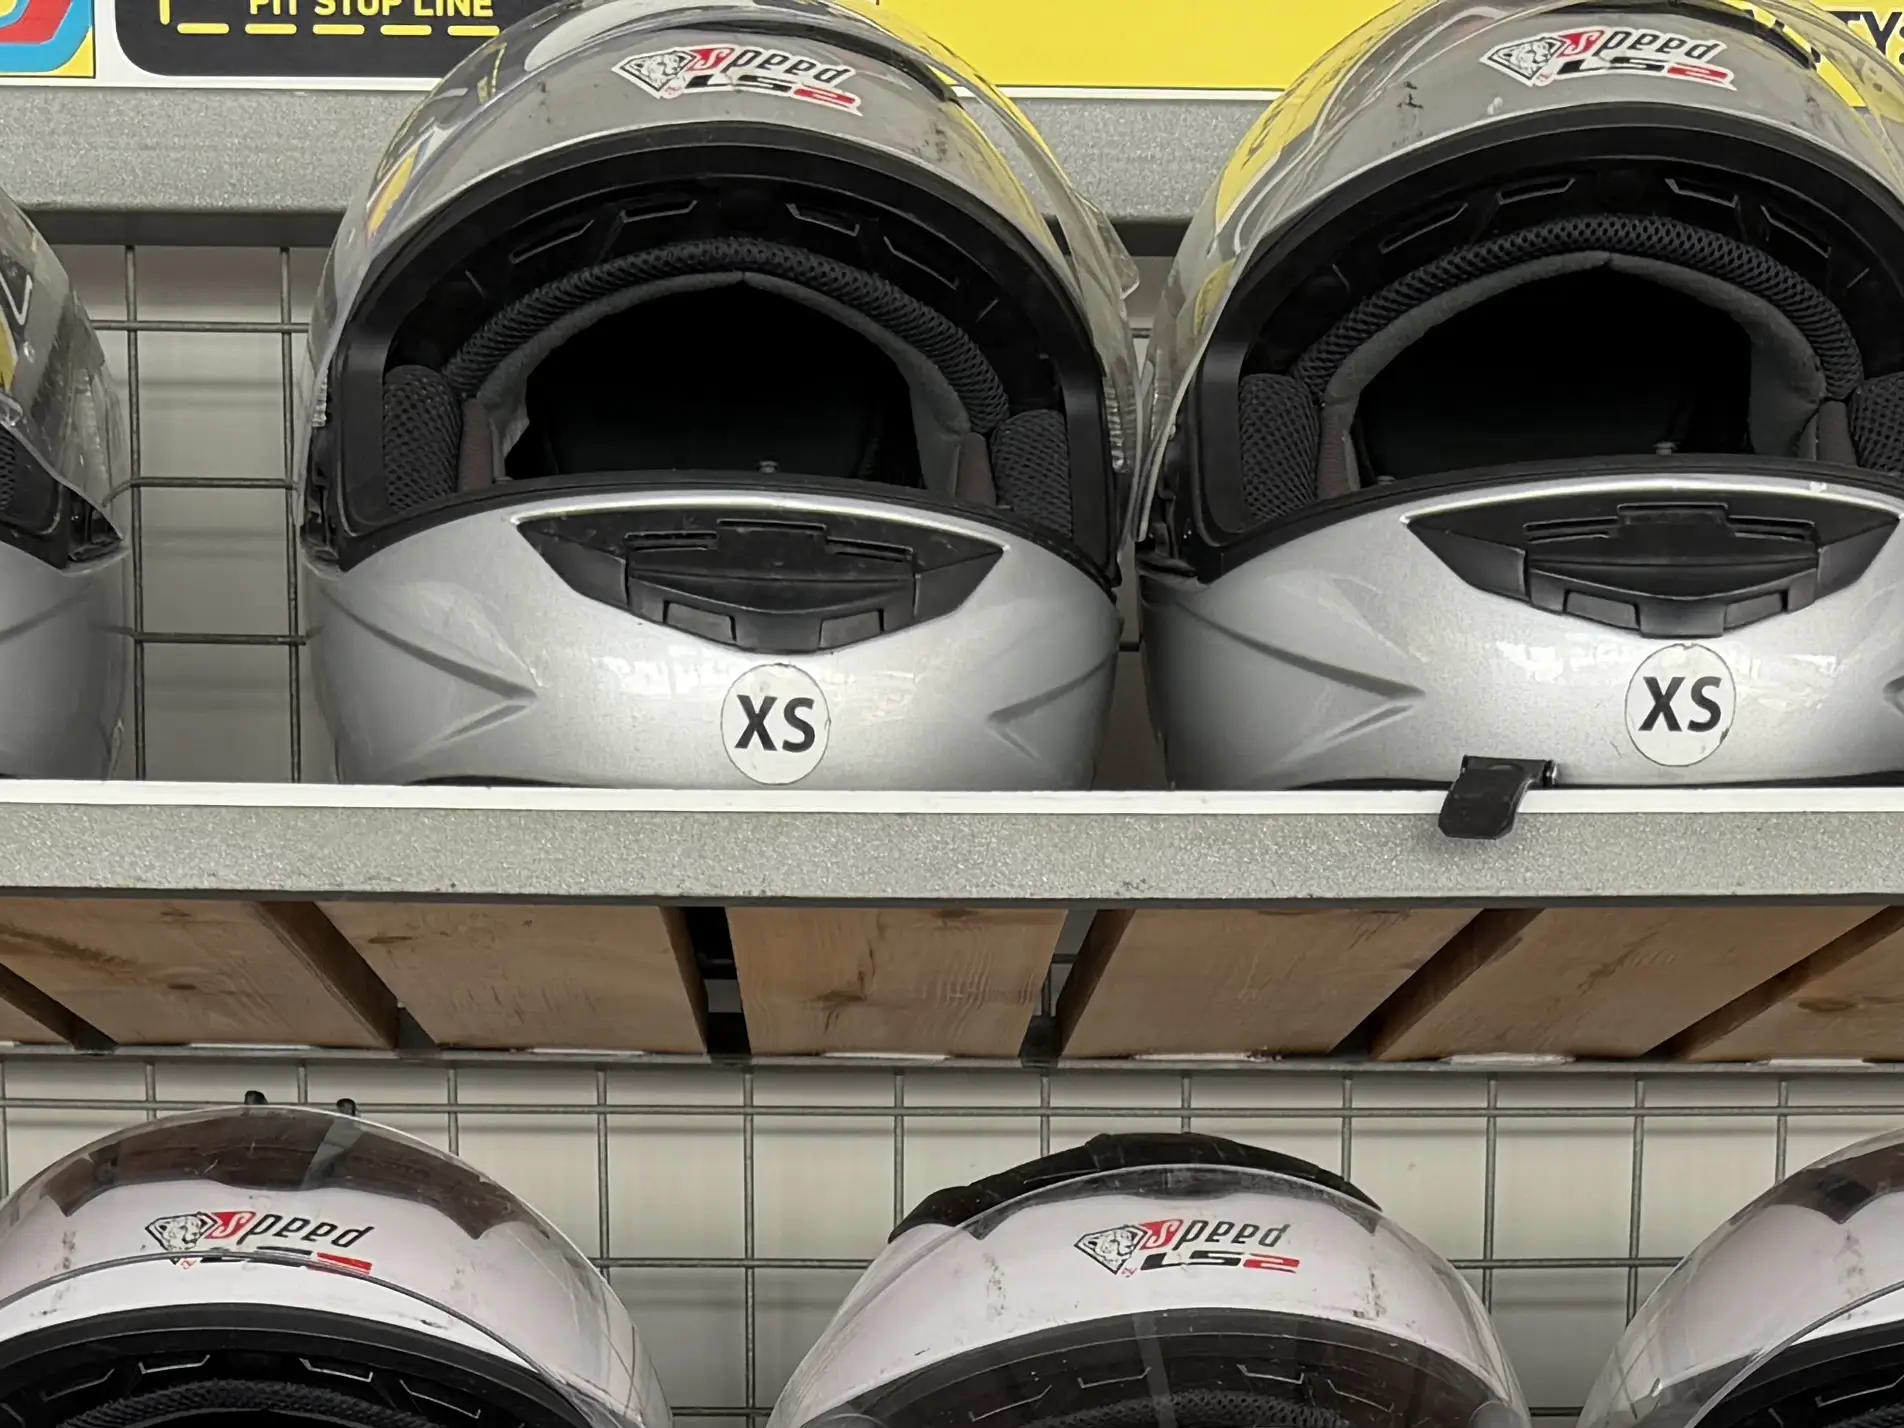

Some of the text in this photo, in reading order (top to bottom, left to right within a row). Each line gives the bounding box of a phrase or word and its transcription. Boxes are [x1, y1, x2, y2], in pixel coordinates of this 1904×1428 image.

[414, 0, 494, 17] LINE
[1558, 30, 1721, 61] Speed
[688, 48, 852, 84] Speed
[1557, 55, 1730, 84] LS2
[685, 75, 858, 107] LS2
[1639, 677, 1721, 731] XS
[736, 695, 815, 752] XS
[204, 1211, 375, 1248] Speed
[1138, 1219, 1291, 1251] Speed
[1140, 1251, 1300, 1273] LS2
